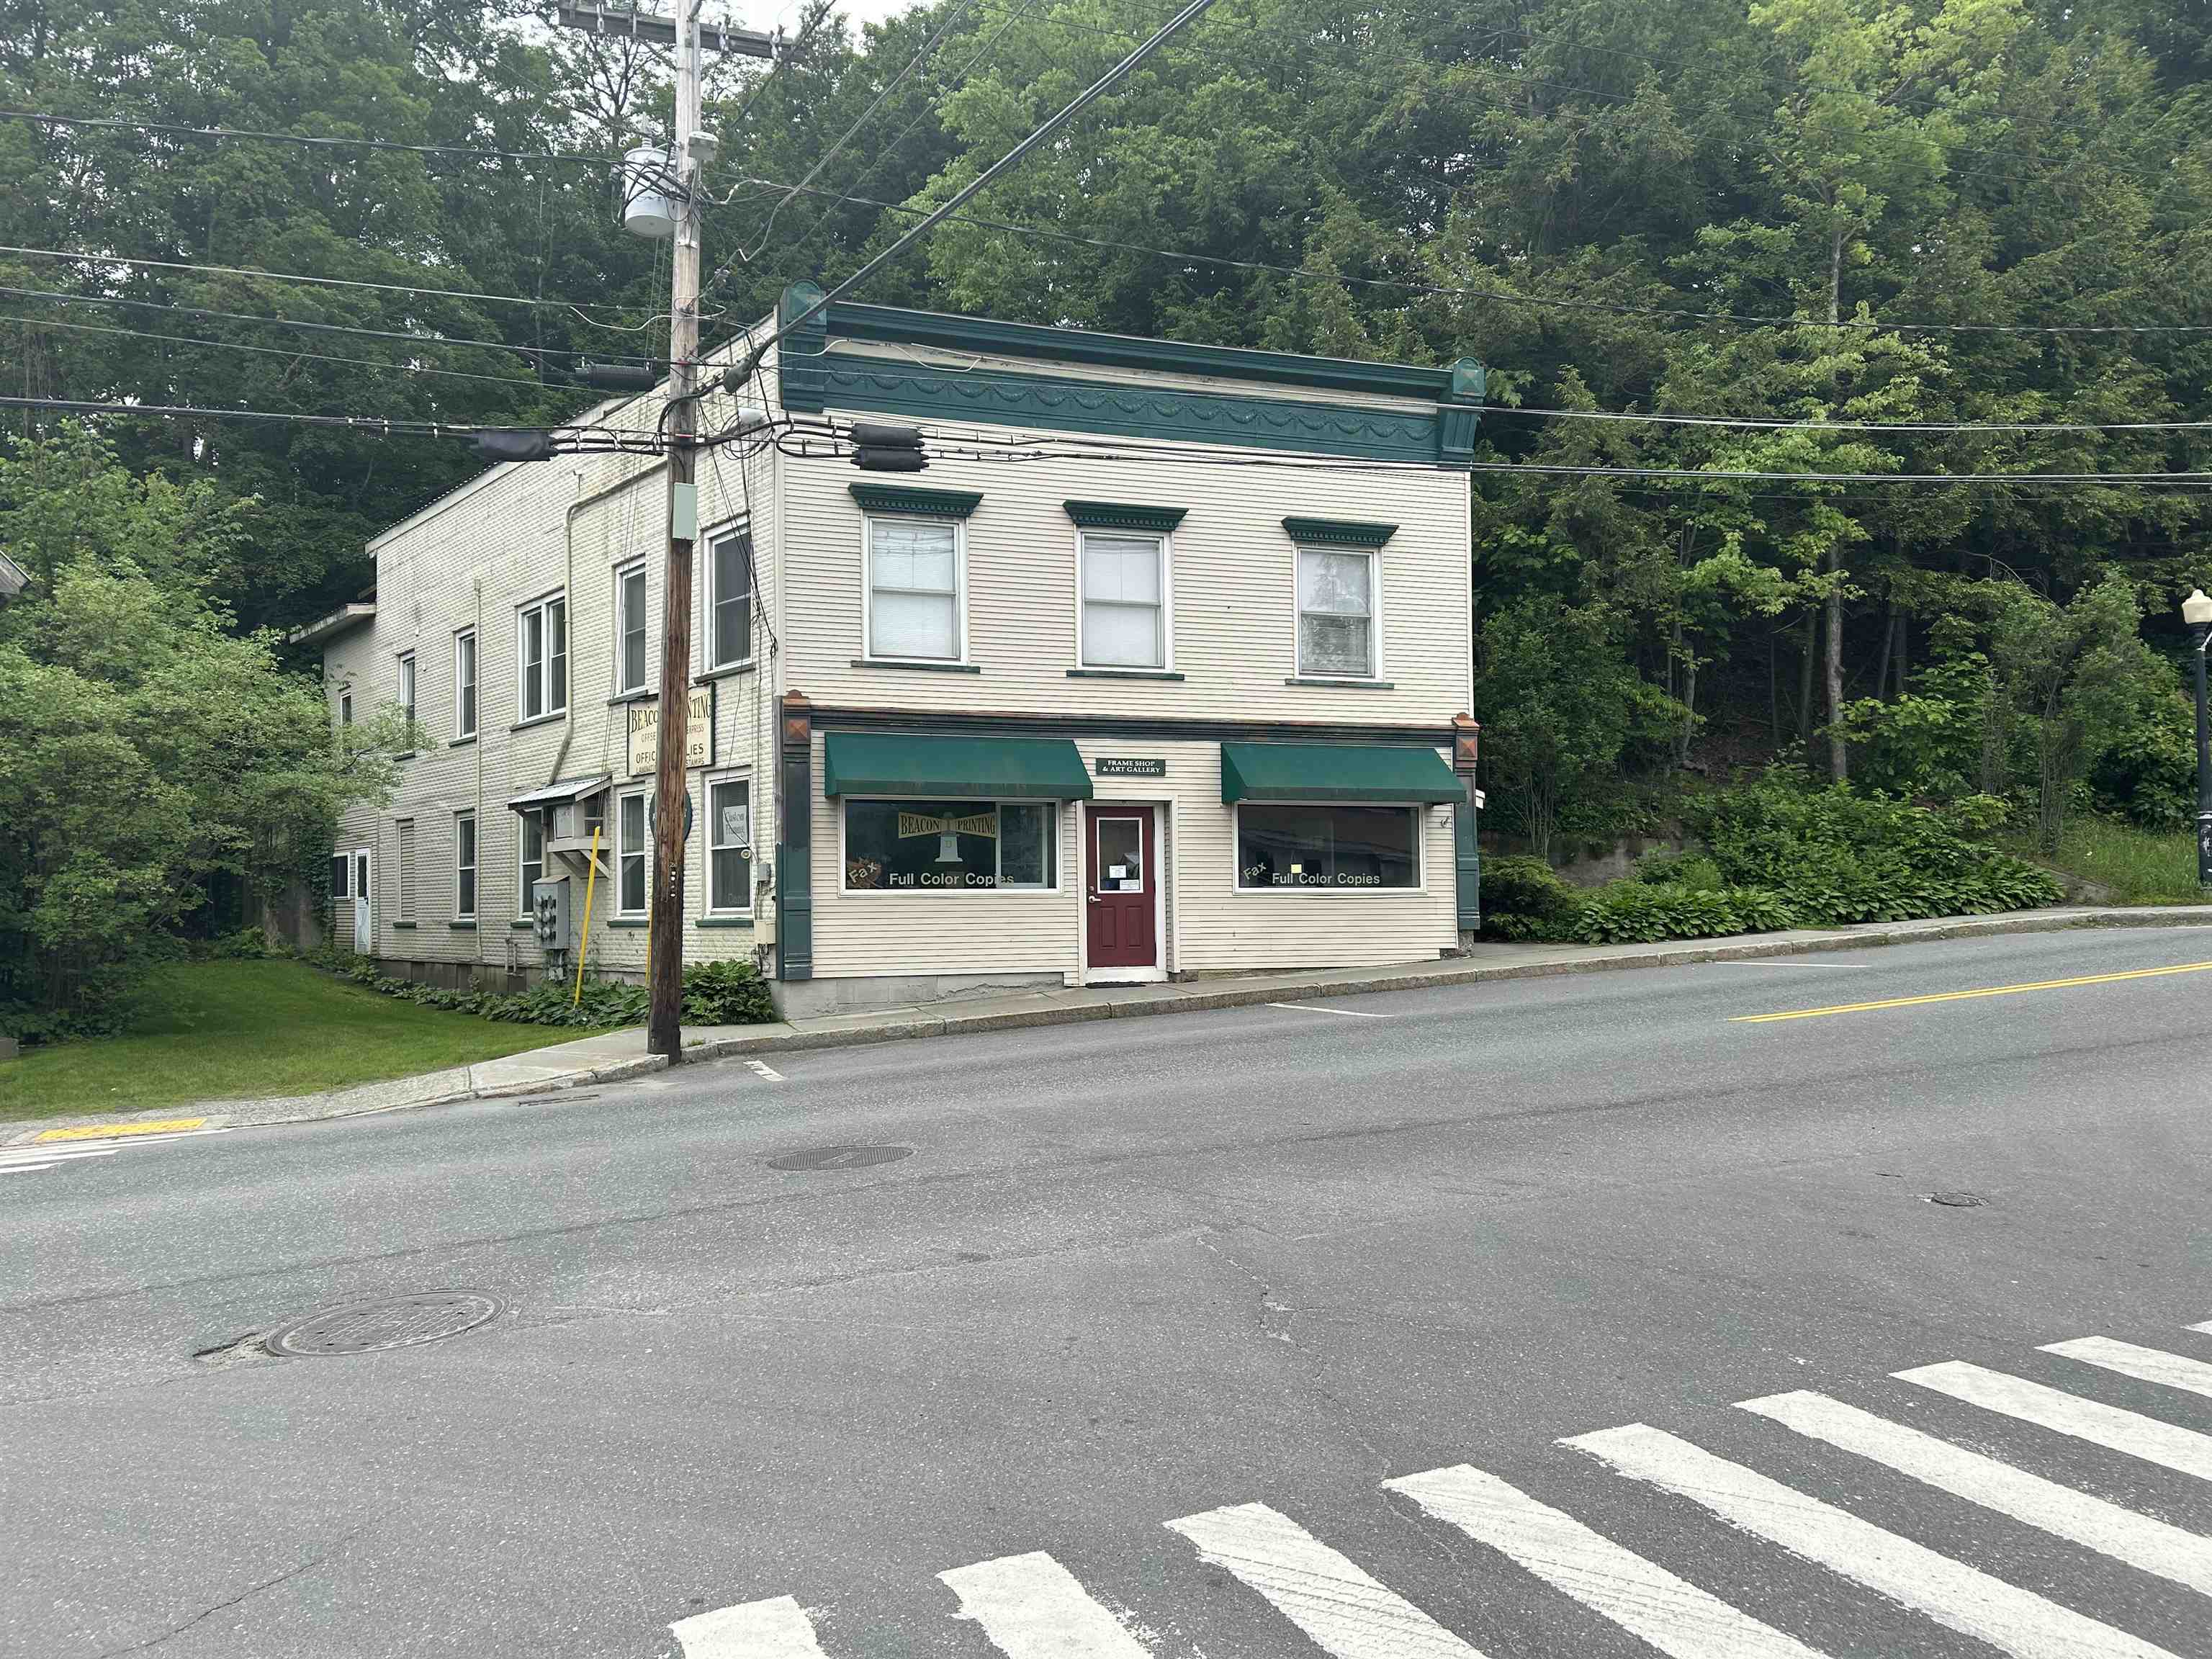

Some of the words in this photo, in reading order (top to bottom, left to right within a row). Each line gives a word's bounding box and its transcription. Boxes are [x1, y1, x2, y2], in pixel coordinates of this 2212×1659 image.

[631, 709, 658, 733] BEACO
[687, 693, 711, 719] NTING
[641, 732, 657, 743] OFFSE
[636, 750, 656, 764] OFFIC
[901, 816, 940, 835] BEACON
[957, 816, 996, 835] PRINTING
[848, 861, 878, 884] Fax
[1243, 862, 1267, 881] Fax
[1272, 872, 1293, 884] Full
[1298, 872, 1332, 885] Color
[1337, 873, 1380, 886] Copies
[889, 873, 914, 886] Full
[920, 873, 960, 886] Color
[966, 873, 1015, 887] Copies
